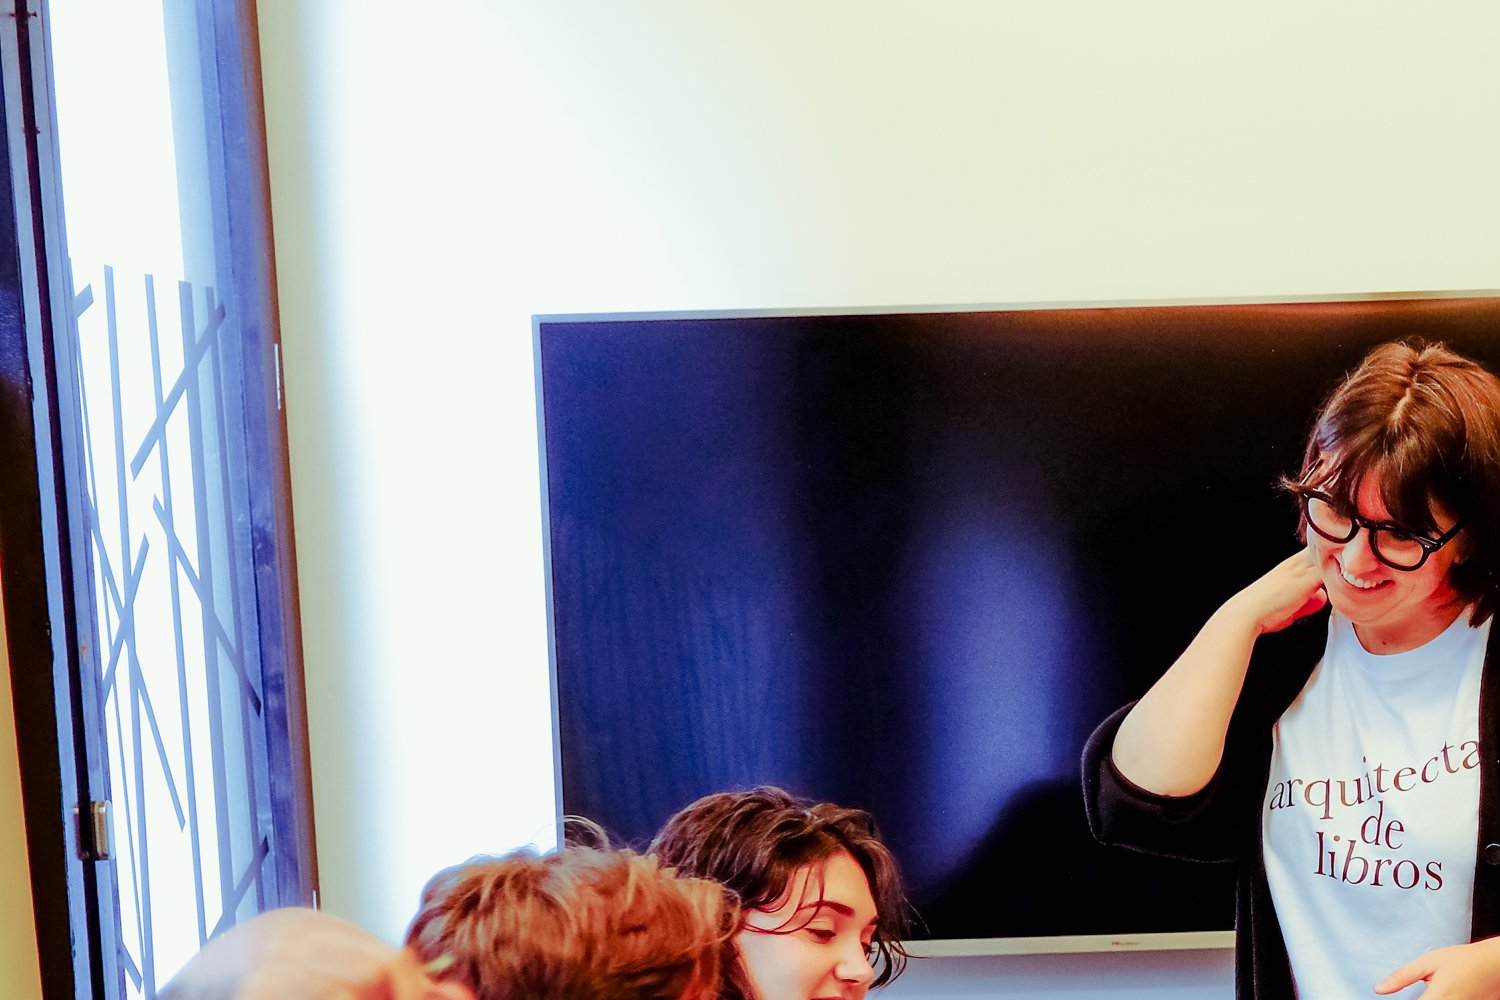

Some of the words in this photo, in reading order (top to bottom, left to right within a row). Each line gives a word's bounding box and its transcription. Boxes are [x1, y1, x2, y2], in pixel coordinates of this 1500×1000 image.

[1268, 740, 1480, 820] arquitecta
[1360, 800, 1405, 850] de
[1313, 831, 1443, 891] libros
